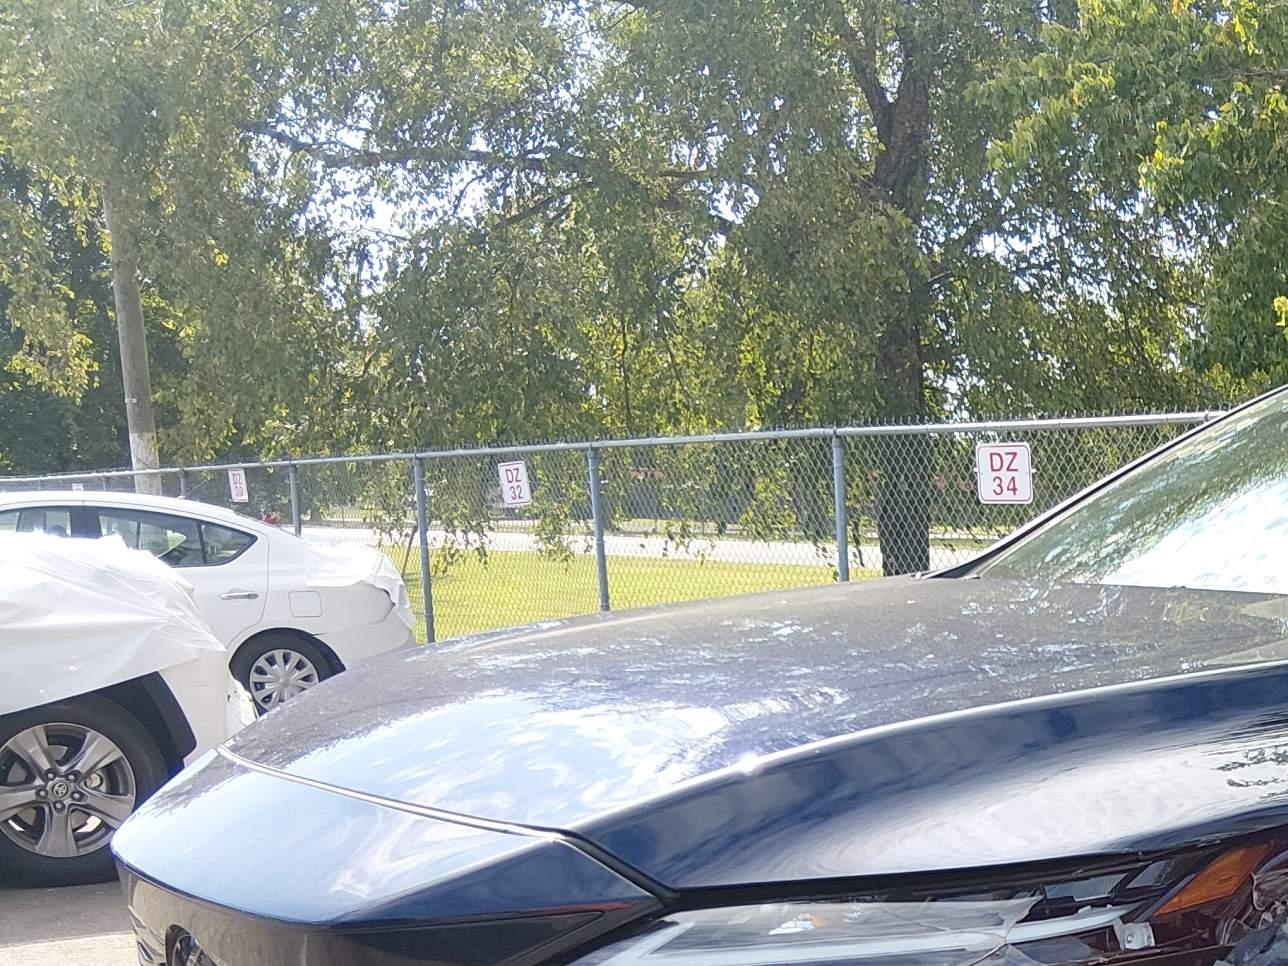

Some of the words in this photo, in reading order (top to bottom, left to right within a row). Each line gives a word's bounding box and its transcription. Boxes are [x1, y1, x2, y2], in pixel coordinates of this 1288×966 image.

[989, 452, 1019, 472] DZ
[505, 468, 522, 483] DZ
[509, 485, 524, 500] 32
[992, 476, 1018, 496] 34
